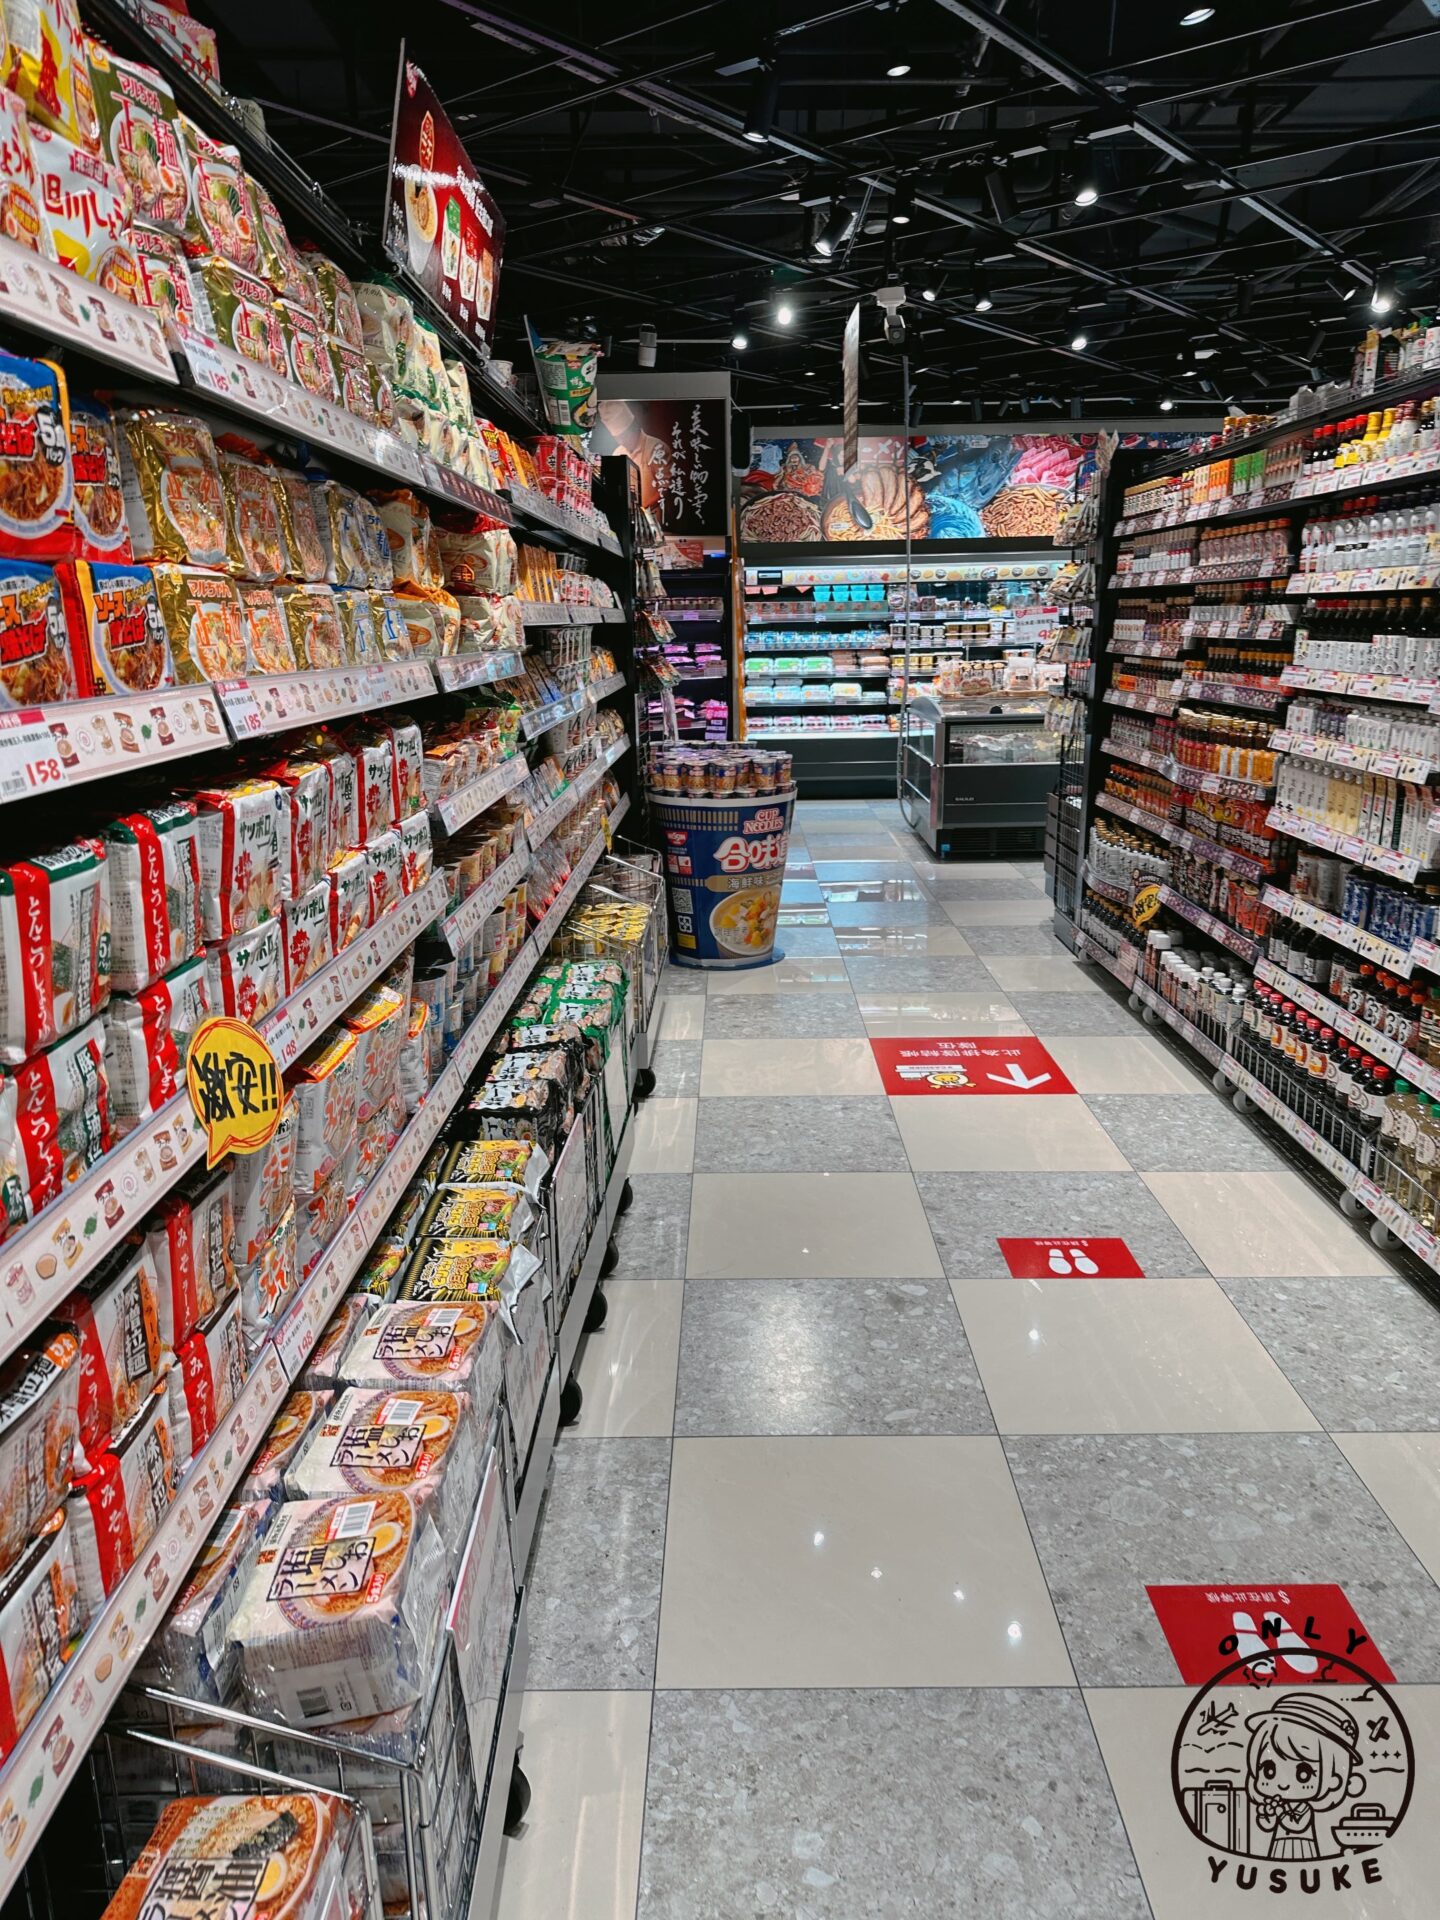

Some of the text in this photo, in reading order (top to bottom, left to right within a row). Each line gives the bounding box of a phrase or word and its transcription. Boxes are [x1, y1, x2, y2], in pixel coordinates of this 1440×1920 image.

[116, 71, 163, 115] マルちゃん
[187, 579, 232, 599] マルちゃん
[94, 590, 127, 623] ソース
[187, 599, 244, 649] 正麺
[244, 713, 262, 732] 185
[26, 758, 61, 786] 158
[239, 813, 272, 843] サッポロ
[743, 818, 784, 834] NOODLES
[756, 810, 778, 820] CUP
[372, 843, 398, 868] サッポロ
[713, 832, 789, 872] 合味道
[728, 876, 764, 889] 海鮮味
[147, 844, 167, 972] とんこつしょうゆ
[27, 894, 51, 1042] とんこつしょうゆ
[281, 1039, 297, 1064] 198
[899, 1049, 1021, 1057] 此為排隊結帳
[191, 1051, 278, 1125] 激安!!
[123, 1281, 149, 1381] 味噌拉麺
[297, 1329, 314, 1359] 198
[377, 1343, 444, 1359] ラーメン
[333, 1448, 411, 1466] ラーメン
[272, 1569, 361, 1597] ラーメン
[364, 1571, 387, 1605] 5食入り
